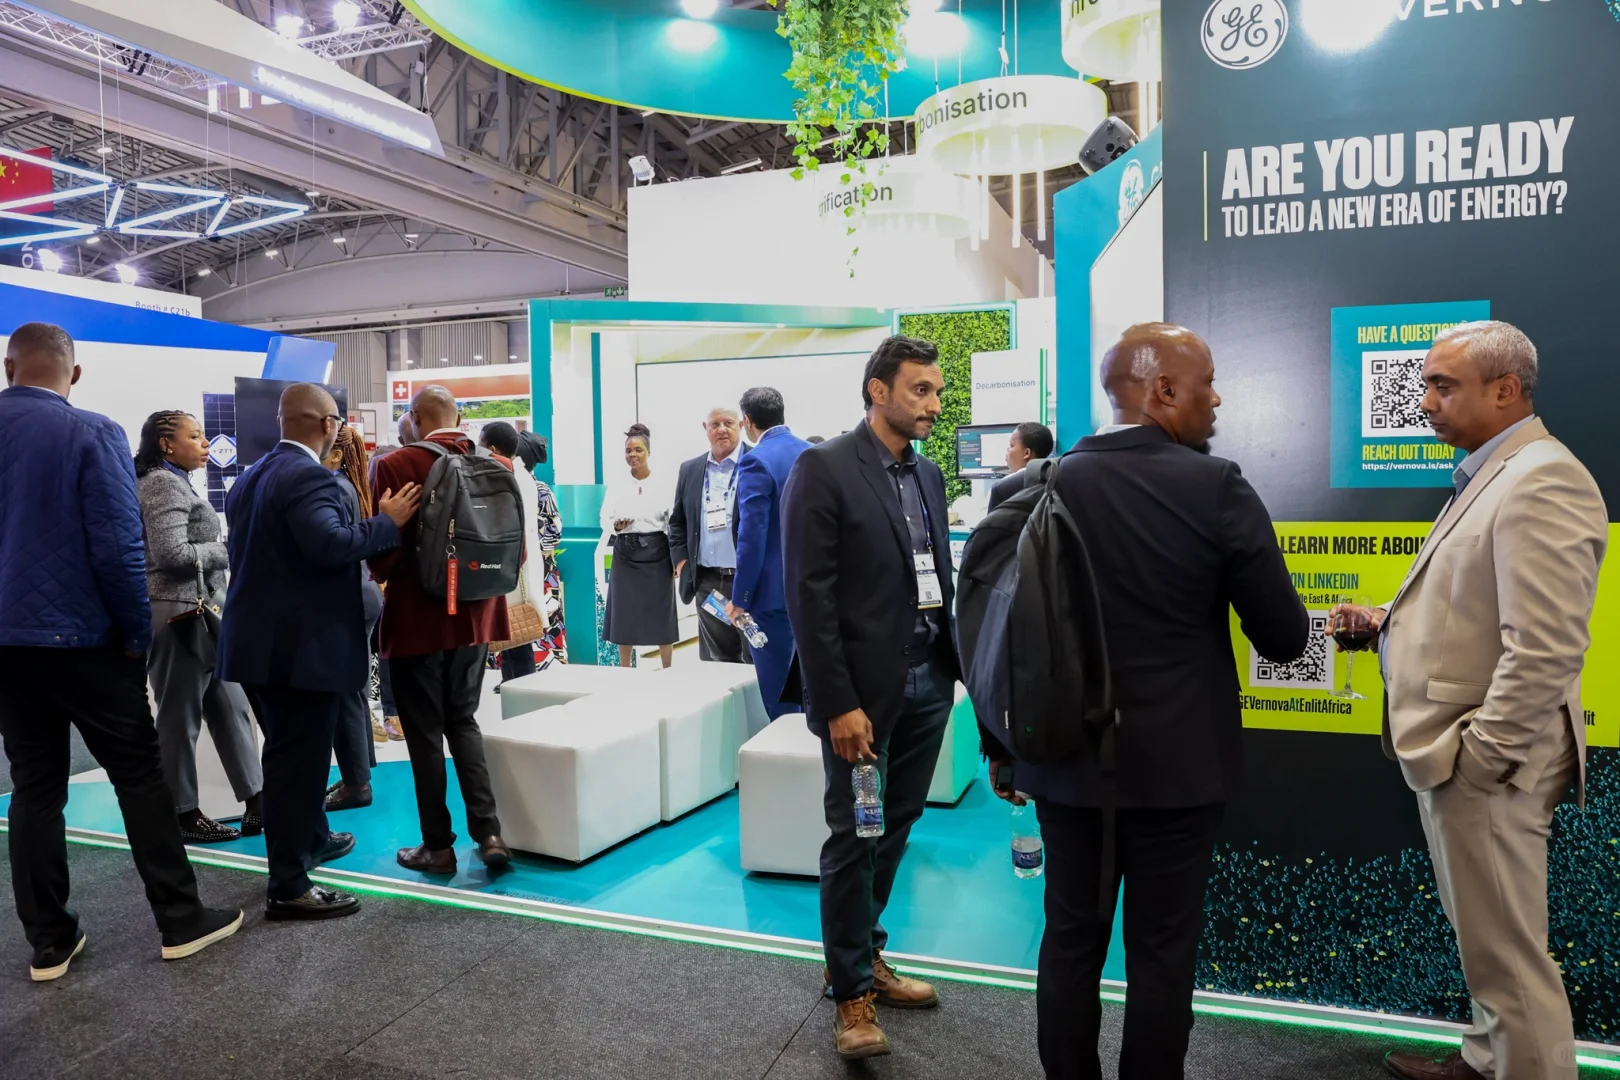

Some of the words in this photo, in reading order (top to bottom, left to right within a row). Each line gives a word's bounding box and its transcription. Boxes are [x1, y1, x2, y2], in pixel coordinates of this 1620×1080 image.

[1222, 143, 1304, 200] ARE
[1314, 133, 1404, 192] YOU
[1415, 116, 1575, 184] READY
[1222, 206, 1248, 237] TO
[1253, 201, 1304, 235] LEAD
[1309, 199, 1324, 232] A
[1328, 195, 1376, 230] NEW
[1380, 191, 1424, 226] ERA
[1428, 188, 1456, 223] OF
[1461, 180, 1568, 220] ENERGY?
[136, 301, 160, 312] Booth
[170, 306, 190, 316] C21b
[1357, 326, 1388, 344] HAVE
[1390, 325, 1398, 342] A
[976, 380, 1036, 390] Decarbonisation
[1362, 444, 1395, 461] REACH
[1398, 444, 1419, 460] OUT
[1422, 444, 1456, 460] TODAY
[1362, 462, 1454, 471] https://vernova.is/ask
[1281, 536, 1329, 555] LEARN
[1332, 536, 1377, 556] MORE
[1308, 572, 1359, 590] LINKEDIN
[1309, 593, 1324, 604] East
[1325, 593, 1330, 604] &
